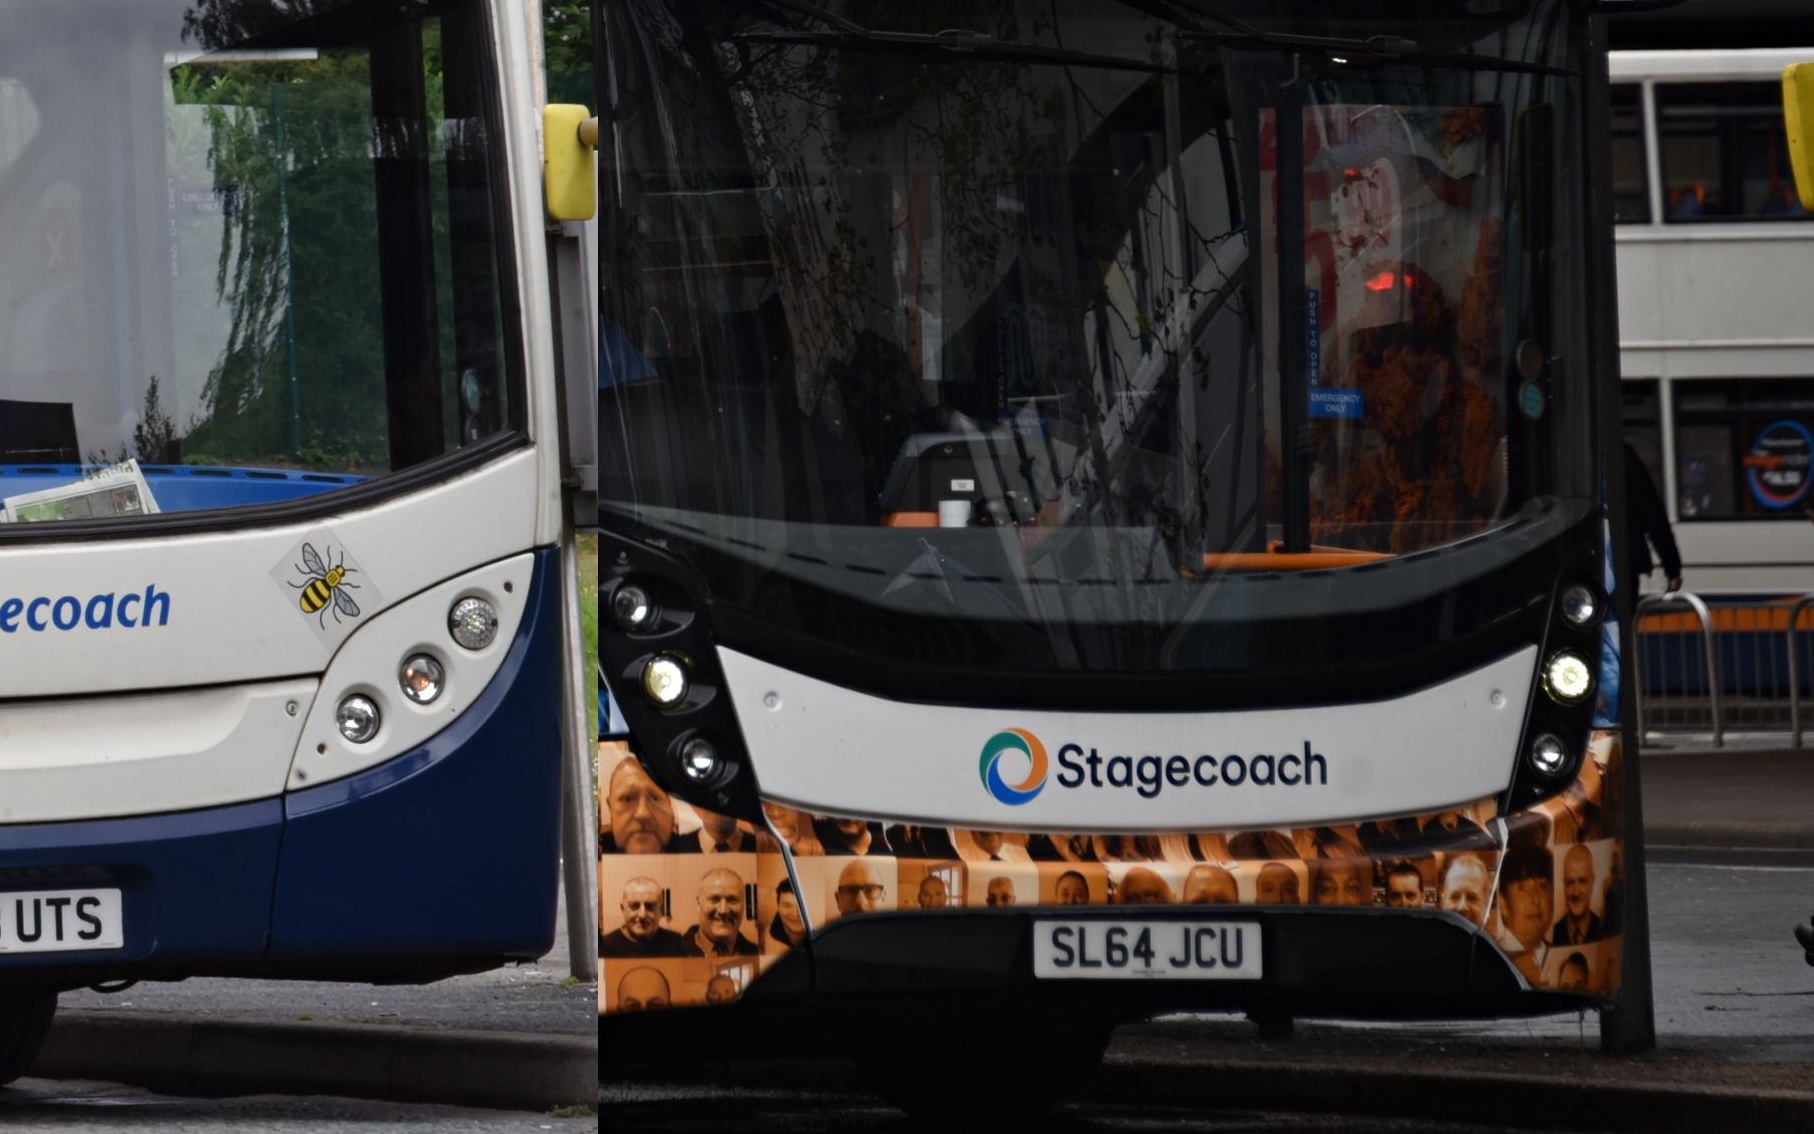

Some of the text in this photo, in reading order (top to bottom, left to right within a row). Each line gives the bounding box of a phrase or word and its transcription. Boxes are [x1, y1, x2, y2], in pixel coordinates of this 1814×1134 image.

[1310, 393, 1361, 403] EMERGENCY
[1325, 404, 1346, 412] ONLY
[1056, 740, 1328, 799] Stagecoach
[15, 896, 103, 943] UTS
[1051, 926, 1244, 969] SL64 JCU
